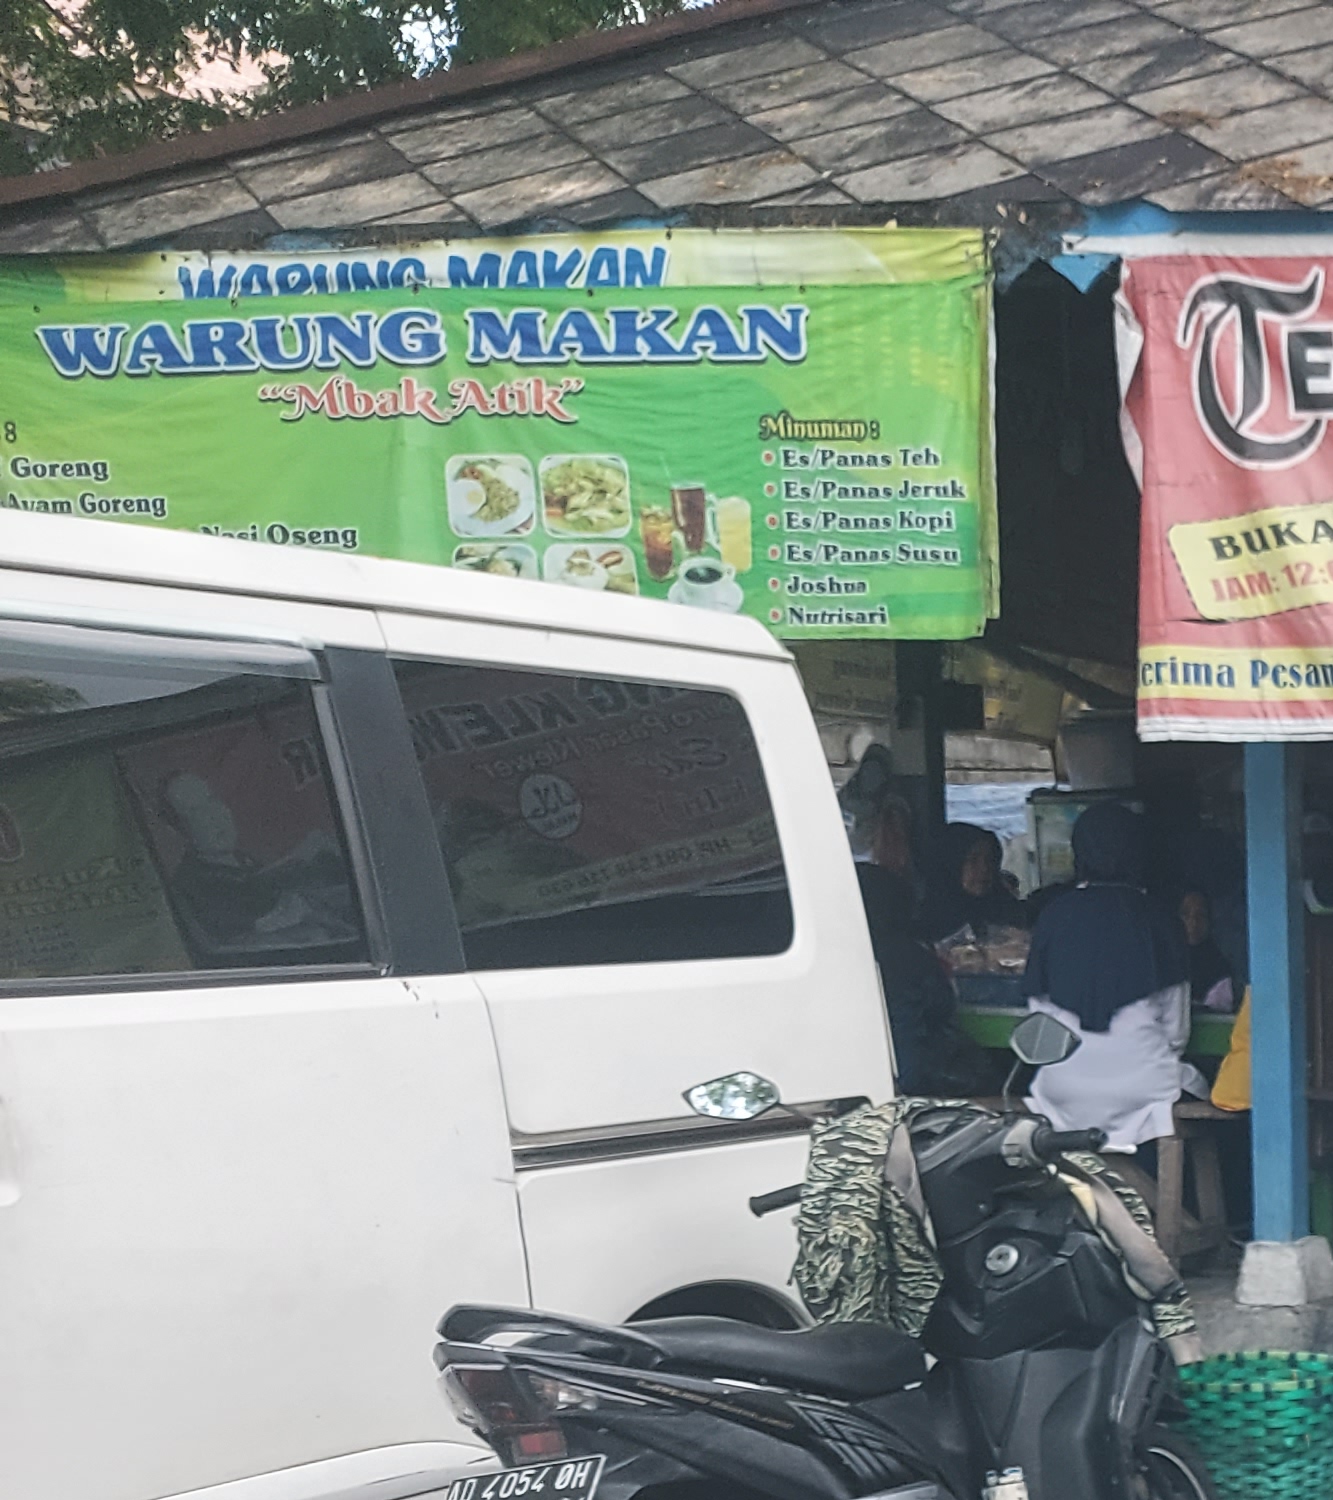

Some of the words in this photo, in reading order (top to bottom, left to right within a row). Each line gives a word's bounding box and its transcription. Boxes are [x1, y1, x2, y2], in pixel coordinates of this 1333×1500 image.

[37, 310, 443, 375] WARUNG
[466, 306, 805, 362] MAKAN
[759, 411, 867, 440] Minuman
[11, 457, 109, 482] Goreng
[782, 449, 892, 467] Es/Panas
[899, 448, 940, 466] Teh
[784, 481, 893, 499] Es/Panas
[899, 480, 966, 499] Jeruk
[80, 493, 166, 517] Goreng
[785, 511, 892, 530] Es/Panas
[899, 511, 954, 533] Kopi
[267, 524, 357, 548] Oseng
[786, 544, 892, 563] Es/Panas
[897, 543, 959, 563] Susu
[787, 576, 867, 594] Joshua
[1210, 571, 1282, 602] JAM:
[788, 606, 887, 625] Nutrisari
[1139, 656, 1236, 688] erima
[480, 1465, 548, 1500] 4054
